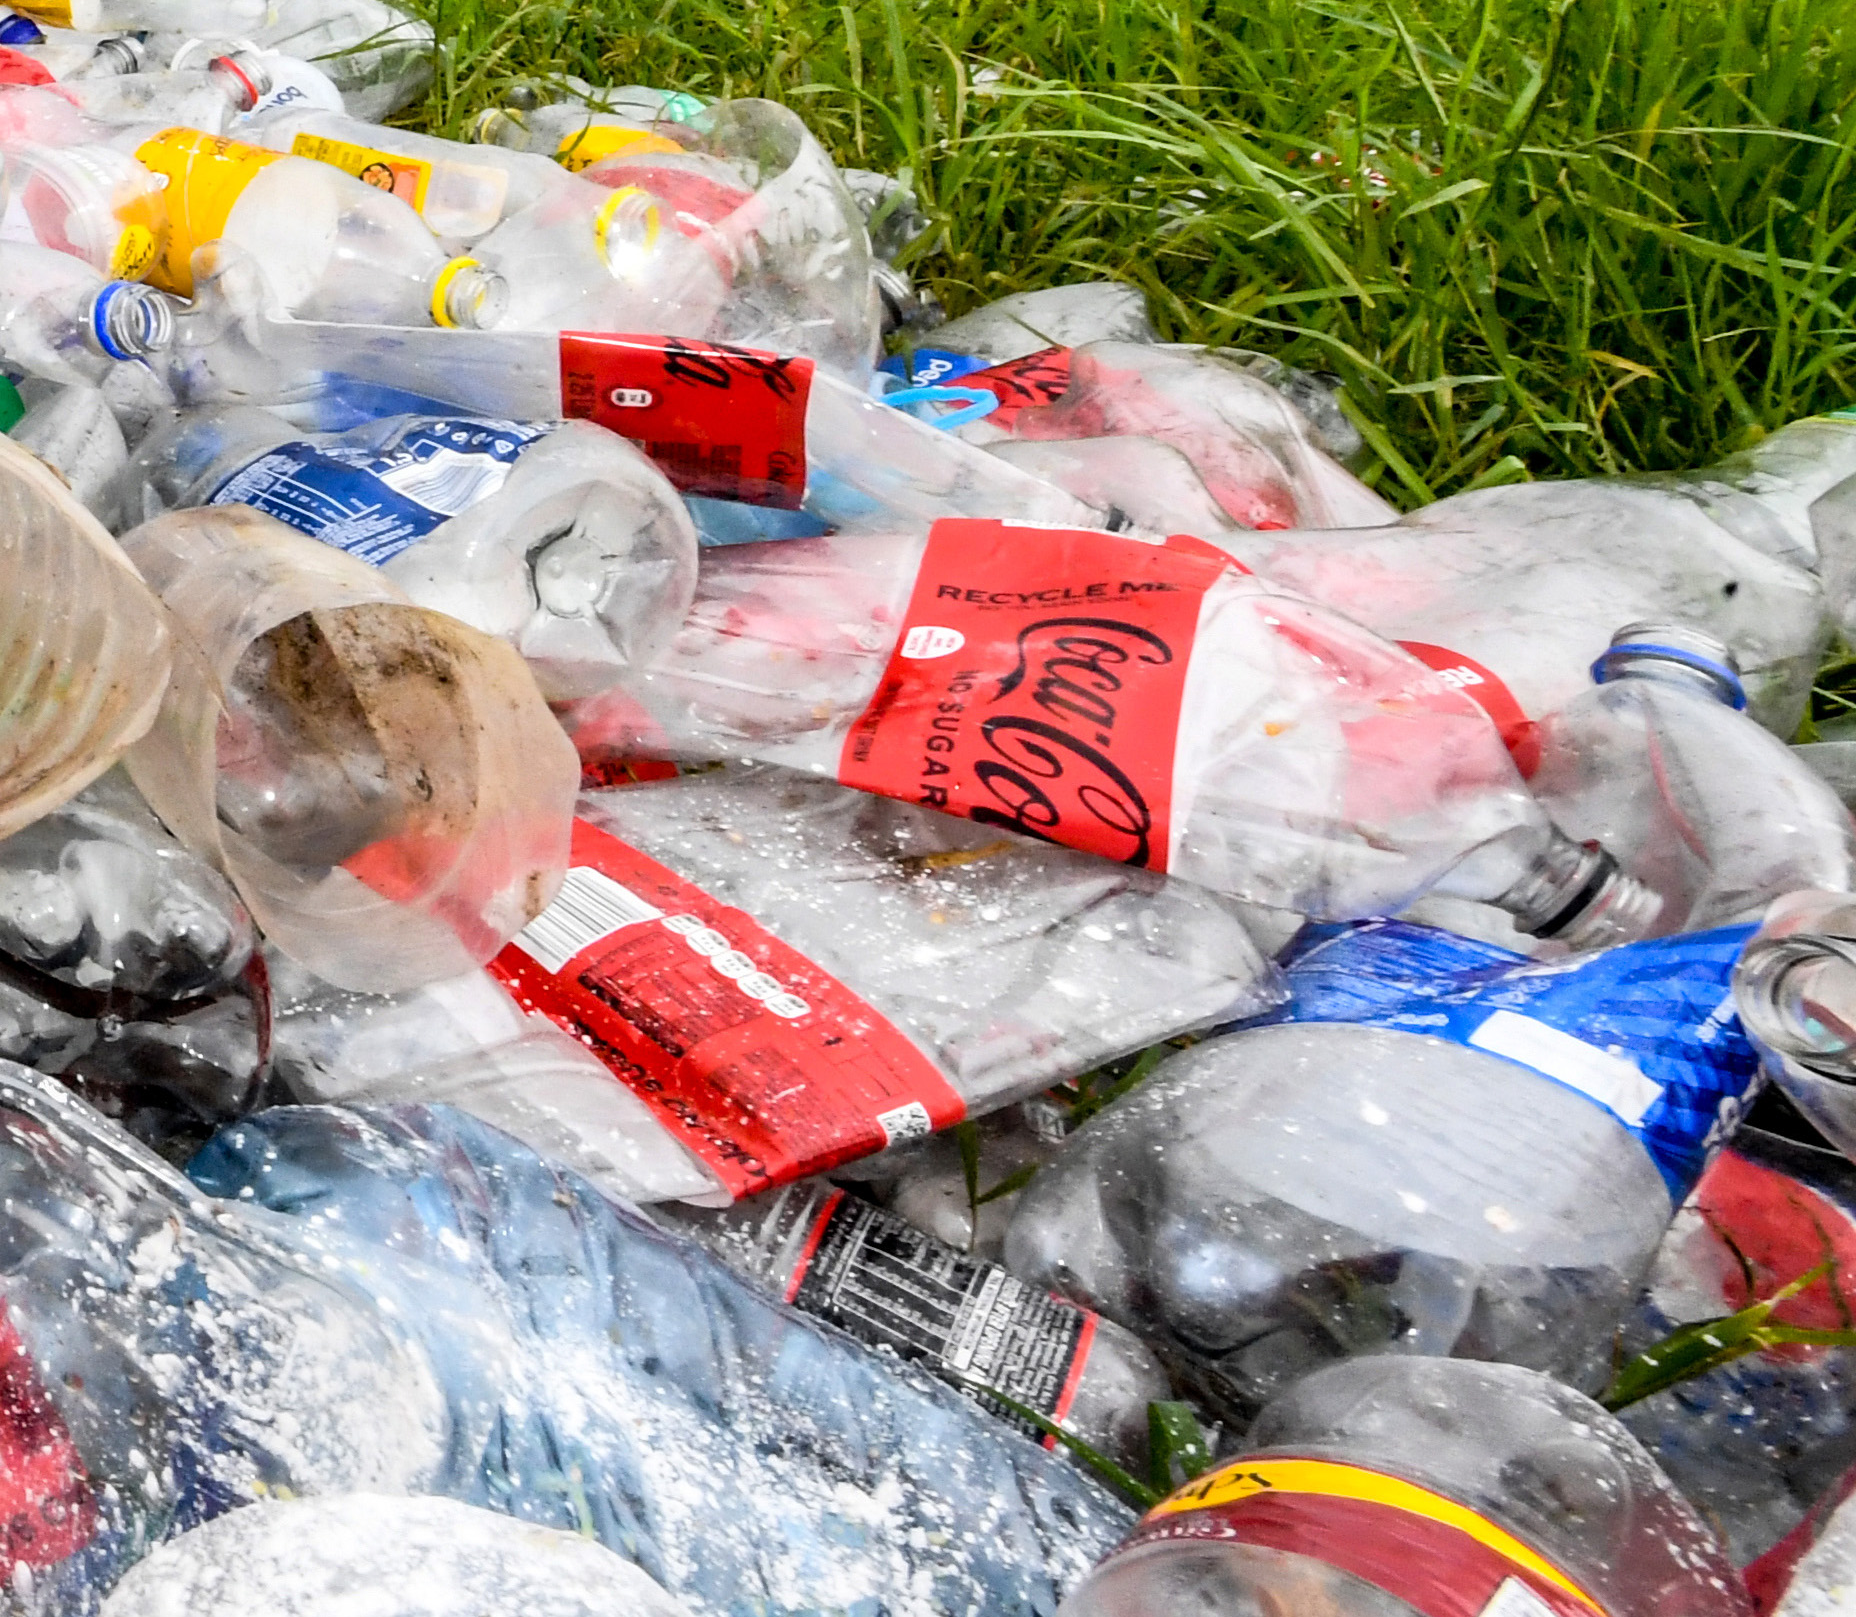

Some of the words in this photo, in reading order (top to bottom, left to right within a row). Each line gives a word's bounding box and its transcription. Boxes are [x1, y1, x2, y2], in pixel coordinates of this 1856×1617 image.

[937, 582, 1110, 608] RECYCLE
[947, 669, 980, 694] NO
[920, 701, 966, 808] SUGAR
